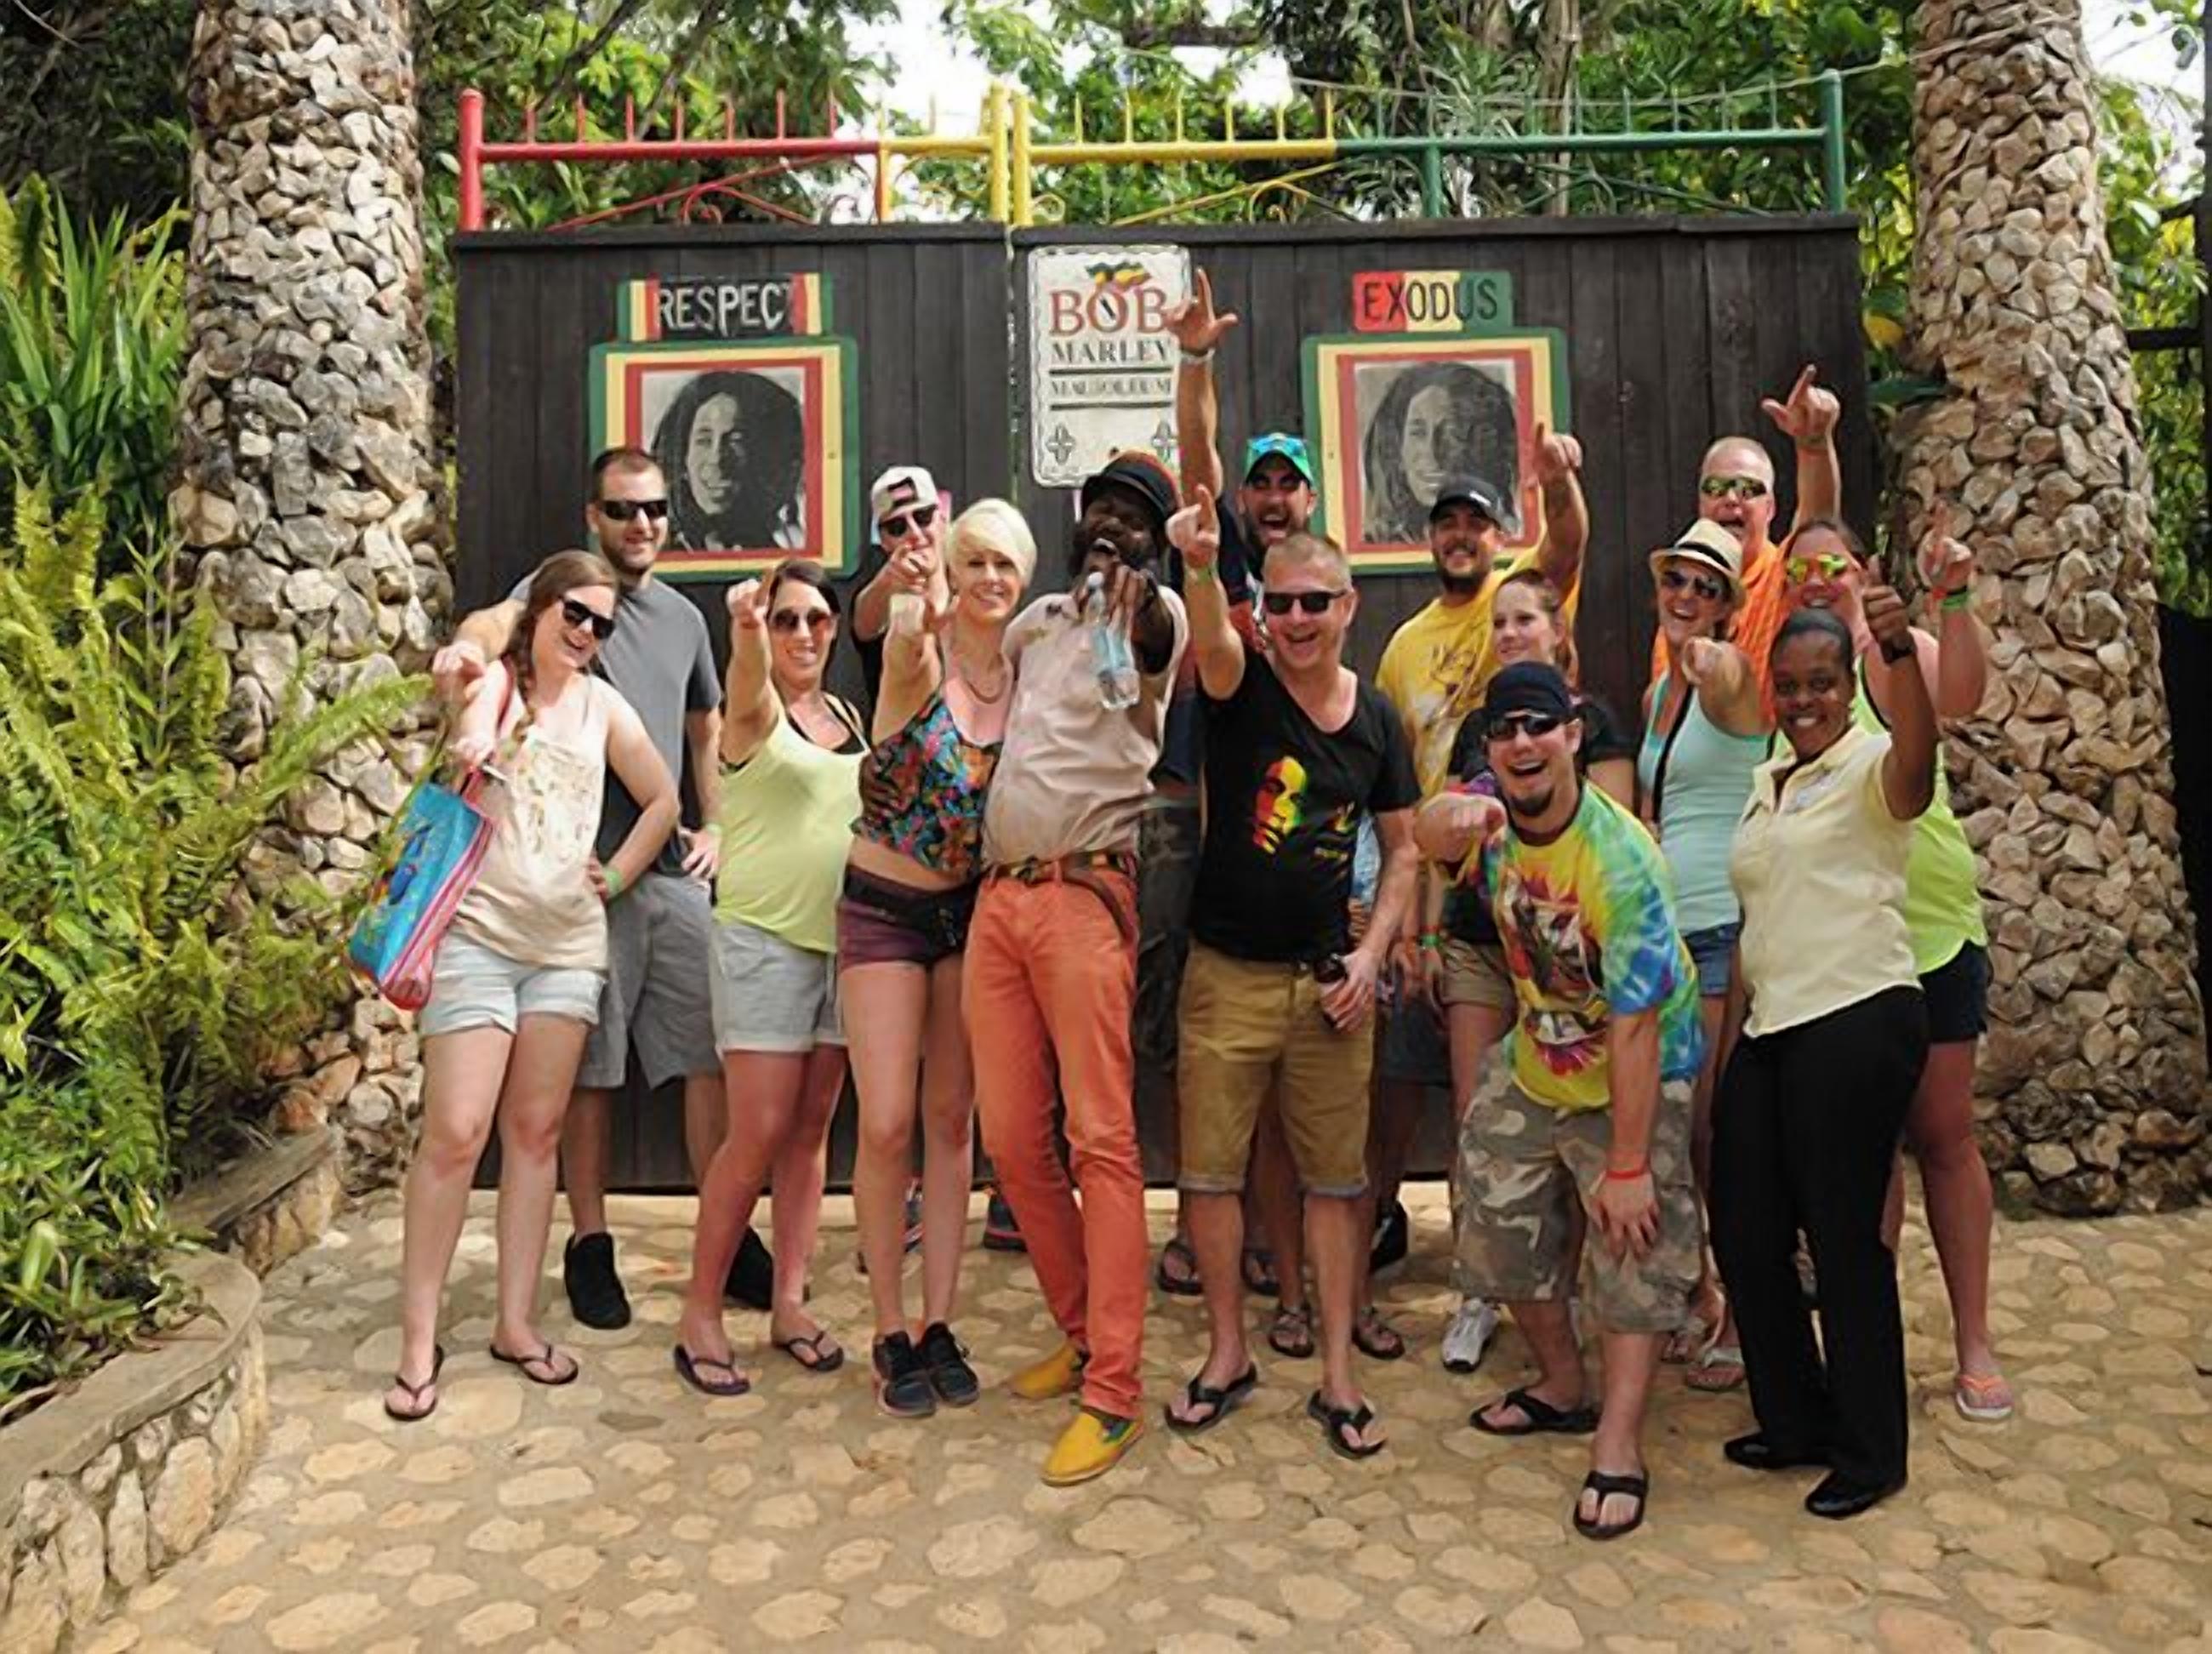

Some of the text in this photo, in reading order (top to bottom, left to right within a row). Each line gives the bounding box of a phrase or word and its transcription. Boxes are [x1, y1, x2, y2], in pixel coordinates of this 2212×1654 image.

[1048, 287, 1172, 335] BOB
[1364, 278, 1498, 322] EXODUS
[1052, 339, 1171, 362] MARLEY
